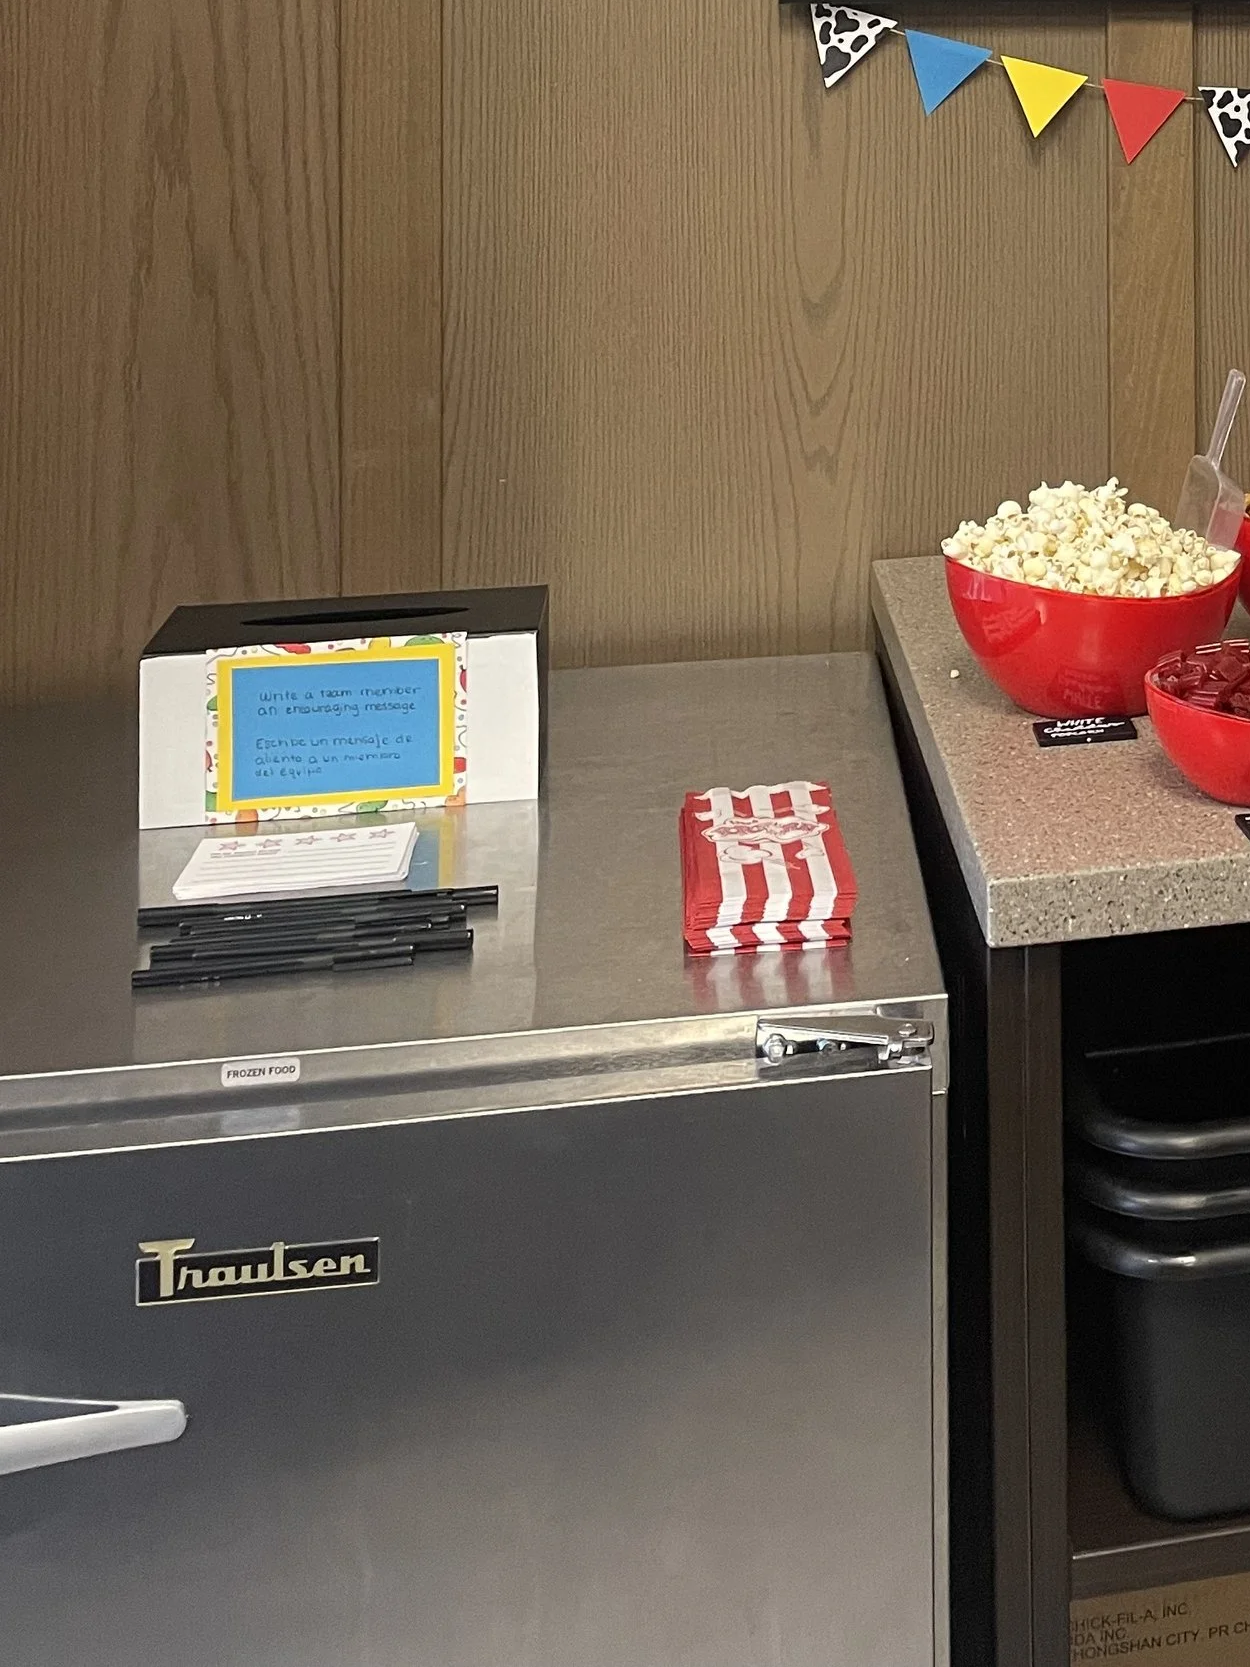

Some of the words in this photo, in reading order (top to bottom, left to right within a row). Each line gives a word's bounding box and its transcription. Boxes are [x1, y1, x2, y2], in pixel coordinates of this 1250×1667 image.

[259, 691, 298, 702] Write
[305, 691, 314, 700] a
[320, 688, 352, 699] team
[360, 685, 421, 697] member
[257, 705, 277, 716] an
[365, 700, 416, 716] message
[311, 737, 328, 747] un
[308, 755, 317, 765] a
[227, 1065, 266, 1079] FROZEN
[268, 1064, 296, 1076] FOOD
[138, 1238, 371, 1297] Traulsen
[1071, 1608, 1157, 1632] HICK-FIL-A,
[1208, 1625, 1229, 1639] PR
